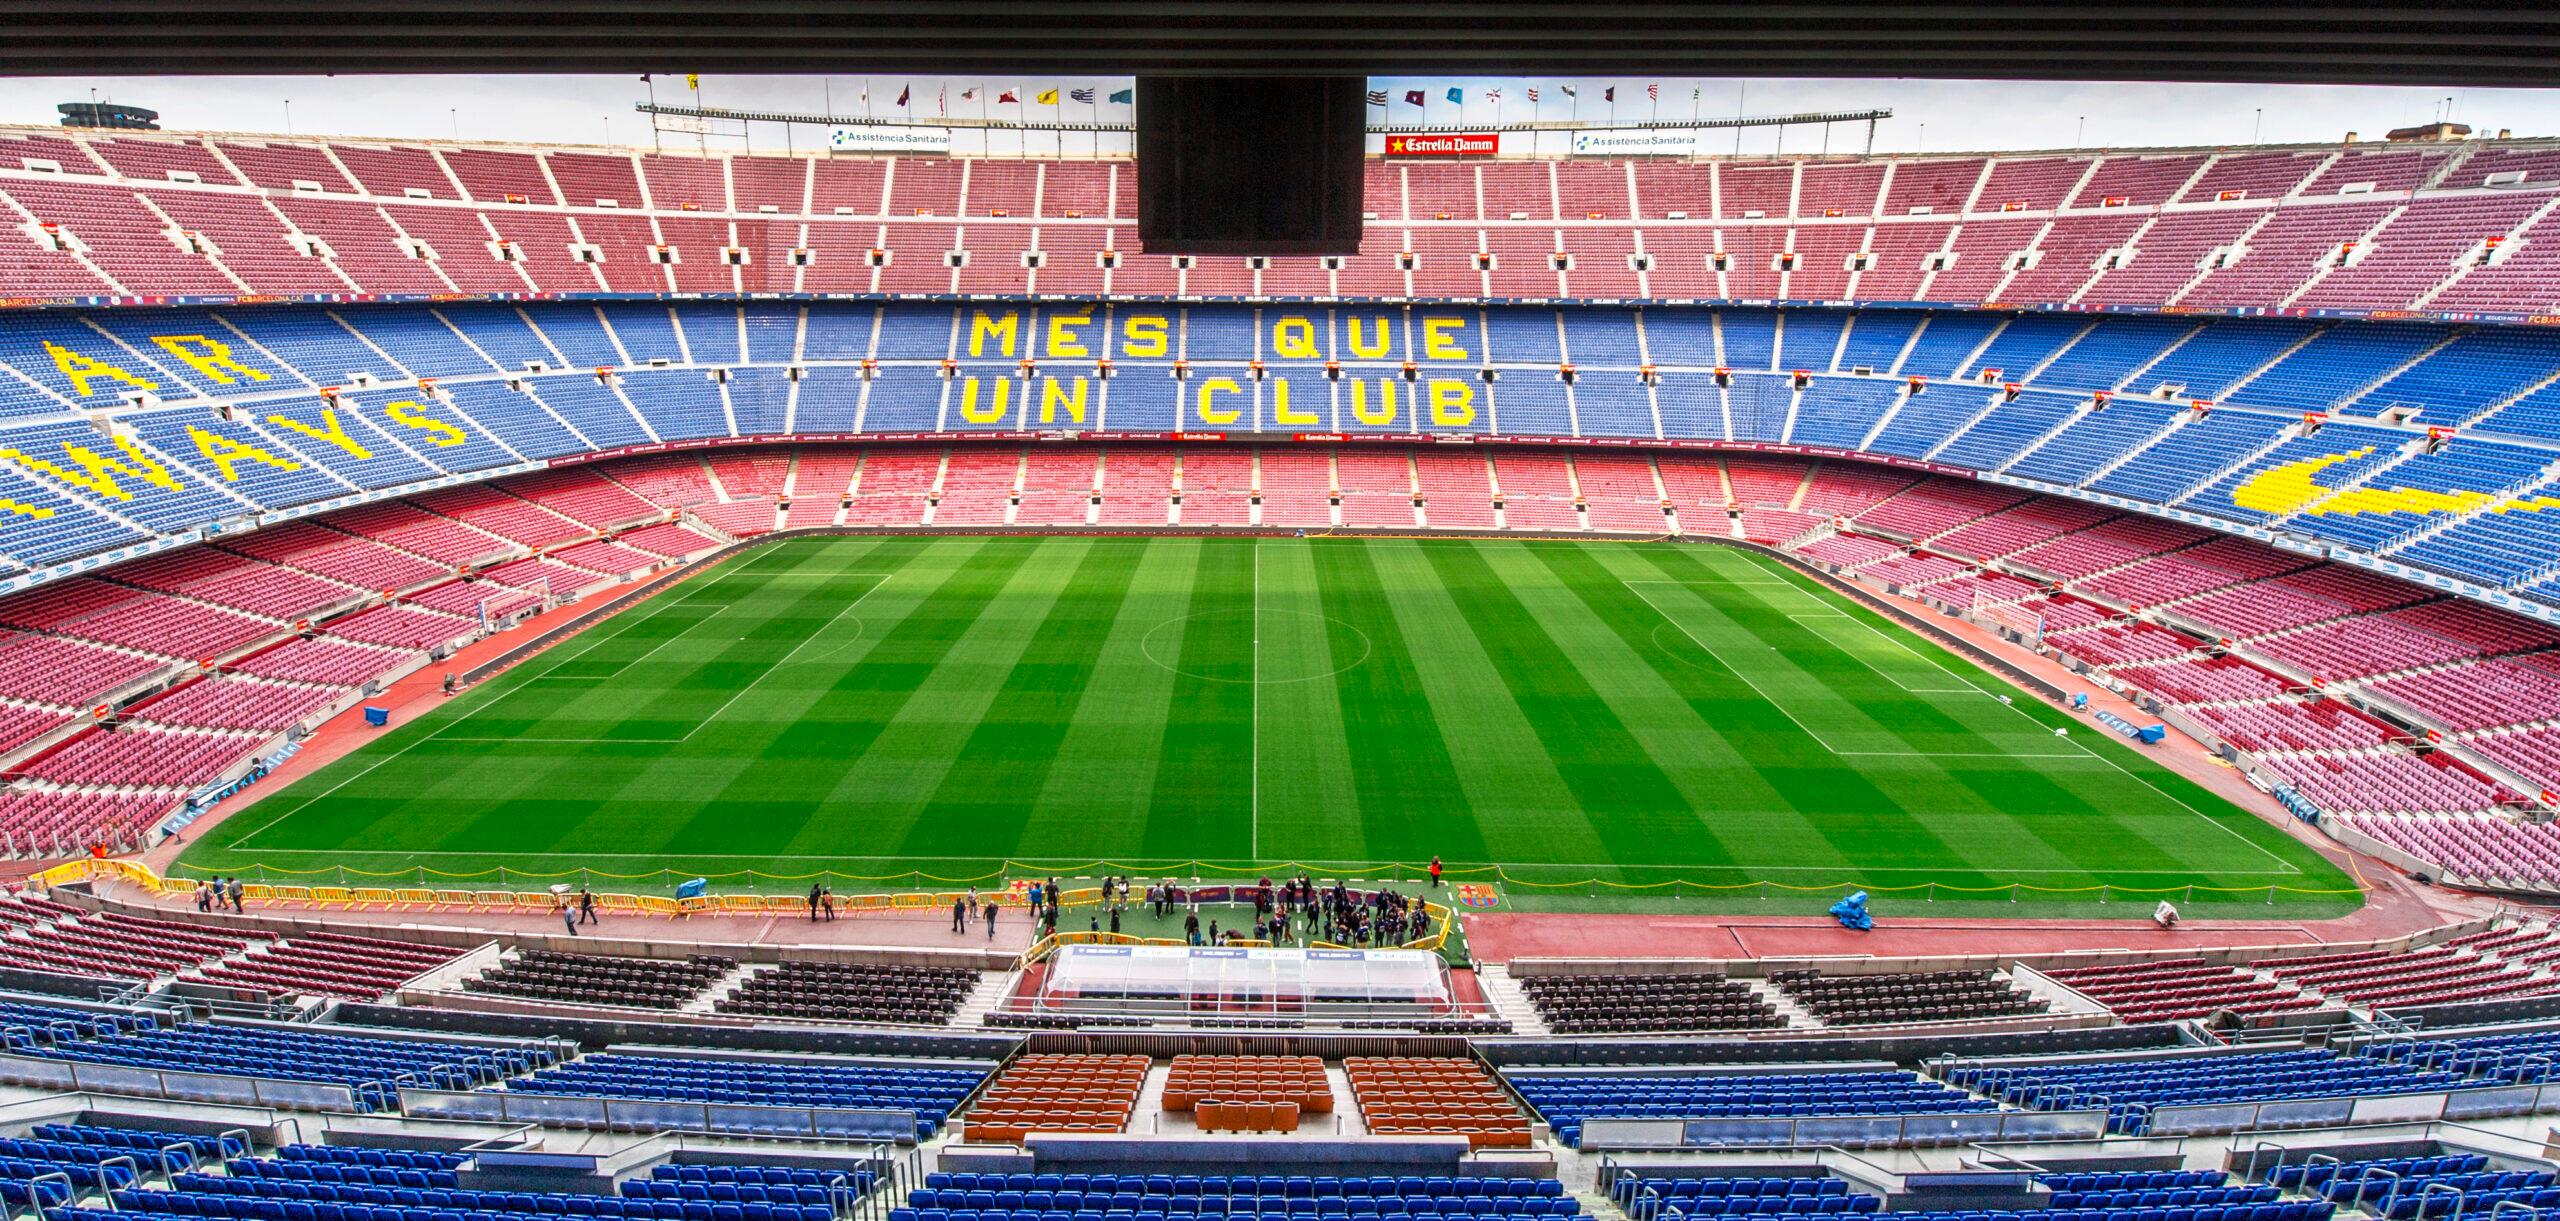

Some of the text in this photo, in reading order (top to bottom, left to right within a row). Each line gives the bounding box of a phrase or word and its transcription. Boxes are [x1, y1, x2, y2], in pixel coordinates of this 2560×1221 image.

[1406, 138, 1493, 152] Estrella Damm
[970, 304, 1467, 359] MÉS QUE
[962, 376, 1476, 426] UN CLUB
[0, 400, 466, 518] WAYS
[134, 544, 150, 552] beko
[109, 551, 125, 559] beko
[82, 558, 99, 566] beko
[2358, 556, 2374, 564] beko
[56, 565, 73, 573] beko
[2383, 562, 2399, 571] beko
[29, 572, 46, 580] beko
[2409, 569, 2426, 578] beko
[2436, 577, 2452, 587] beko
[2463, 584, 2480, 594] beko
[2491, 592, 2509, 602] beko
[2520, 601, 2538, 612] beko
